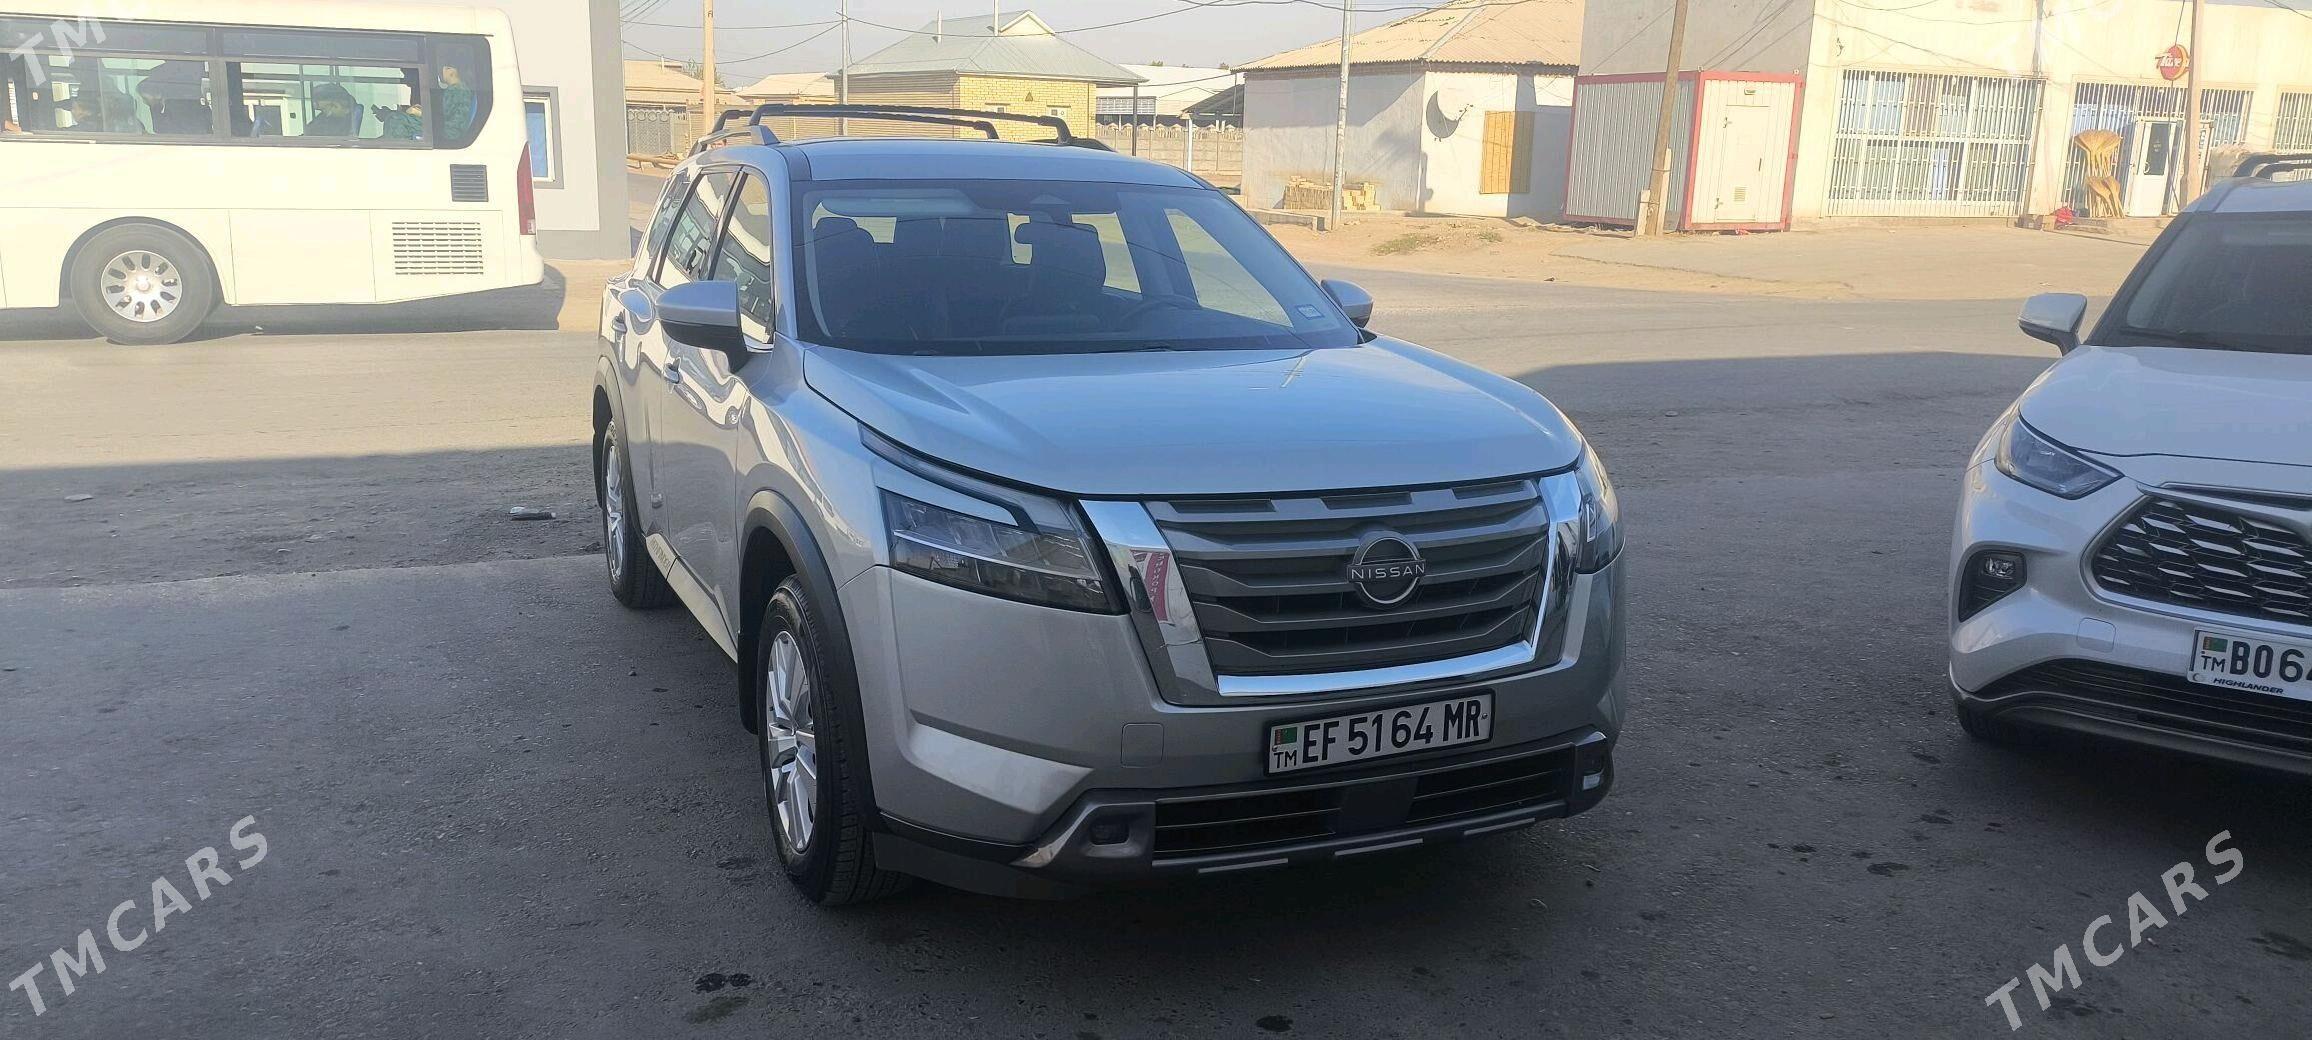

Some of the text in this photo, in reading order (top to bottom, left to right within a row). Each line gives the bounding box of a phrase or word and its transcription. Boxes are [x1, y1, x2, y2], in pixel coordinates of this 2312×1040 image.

[1352, 563, 1425, 579] NISSAN
[2201, 655, 2226, 673] TM
[2213, 677, 2284, 694] HIGHLANDER
[1302, 699, 1482, 764] EF 5164 MR
[1273, 749, 1297, 769] TM
